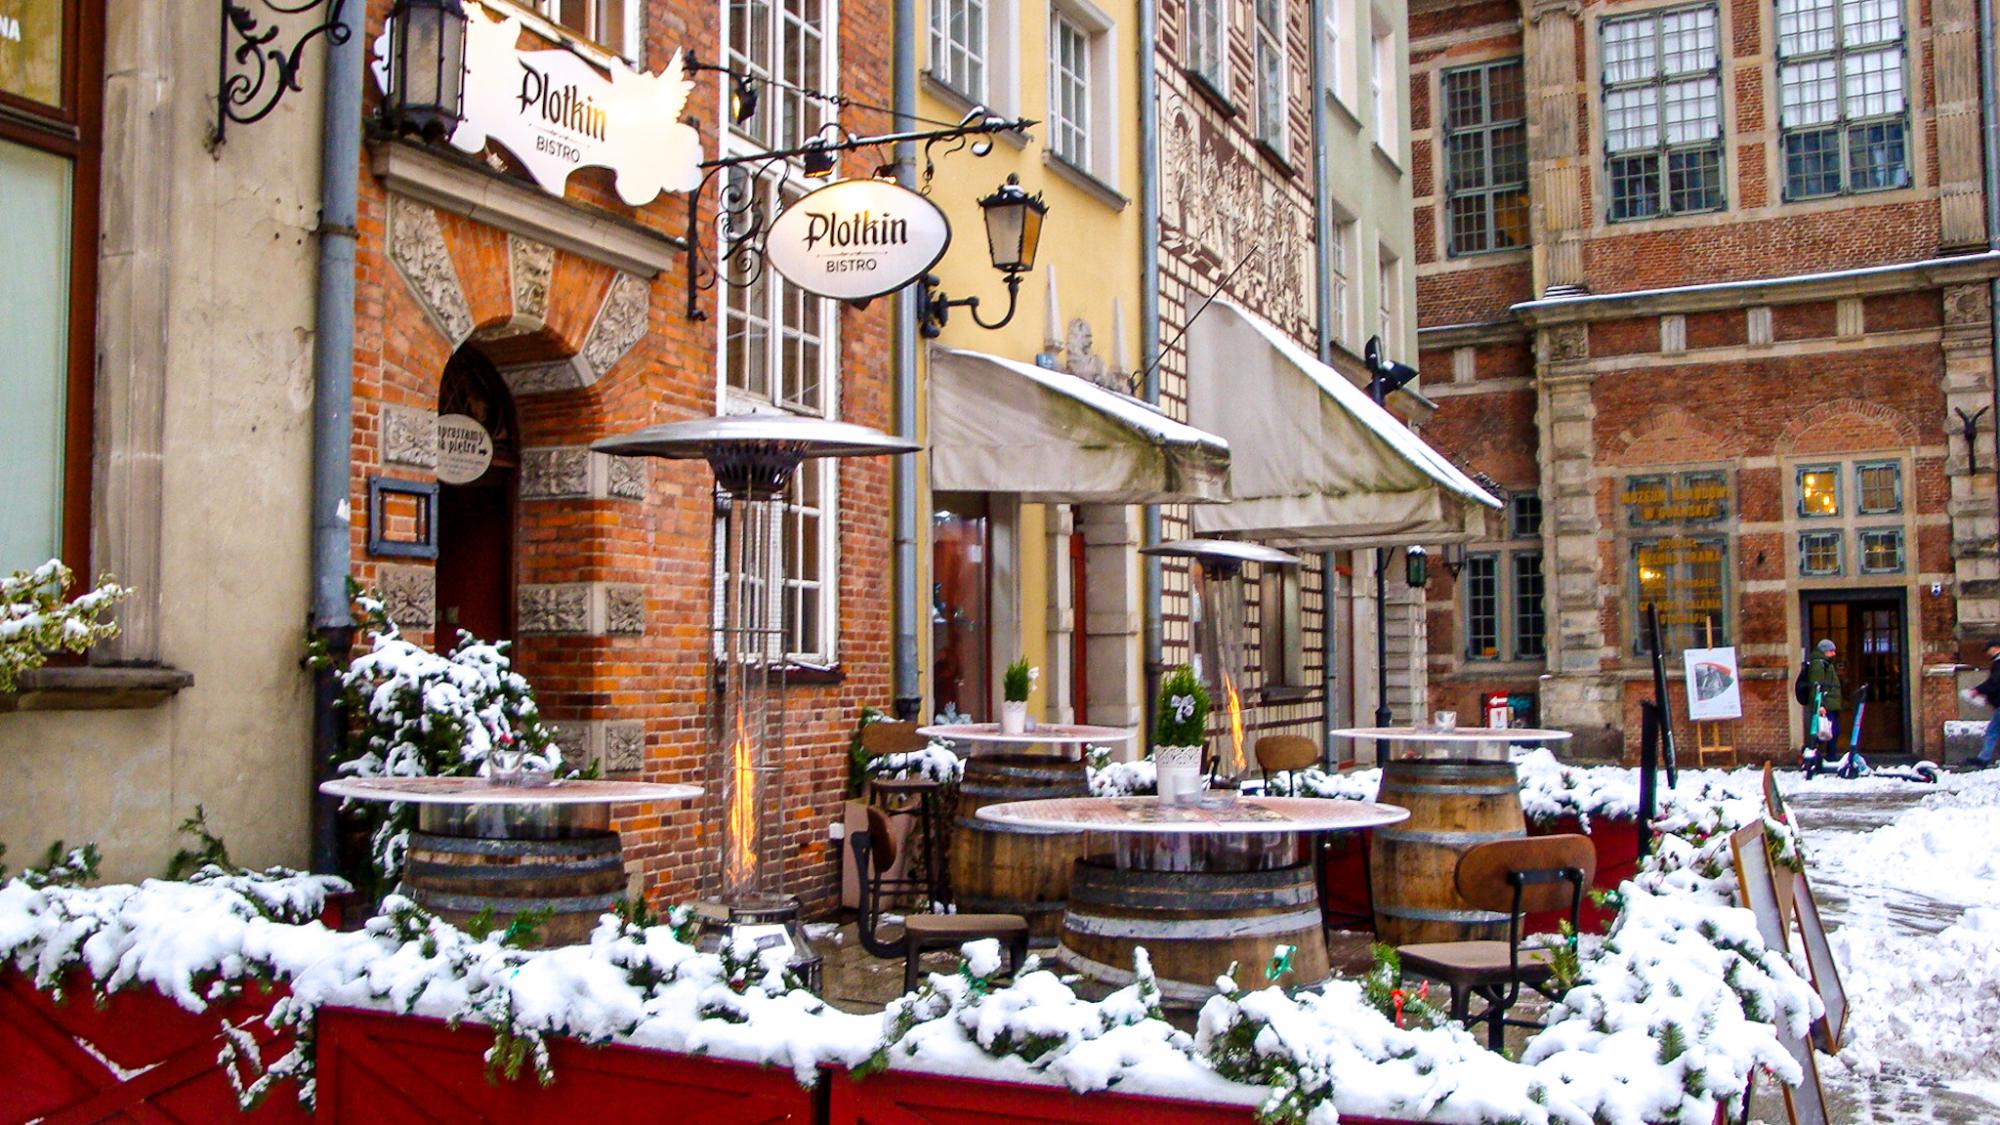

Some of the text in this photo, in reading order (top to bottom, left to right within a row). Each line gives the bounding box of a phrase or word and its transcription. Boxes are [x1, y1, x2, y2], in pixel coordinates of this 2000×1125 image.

[516, 57, 606, 142] Plotkin
[536, 136, 580, 163] BISTRO
[802, 209, 908, 252] Plotkin
[826, 258, 877, 272] BISTRO
